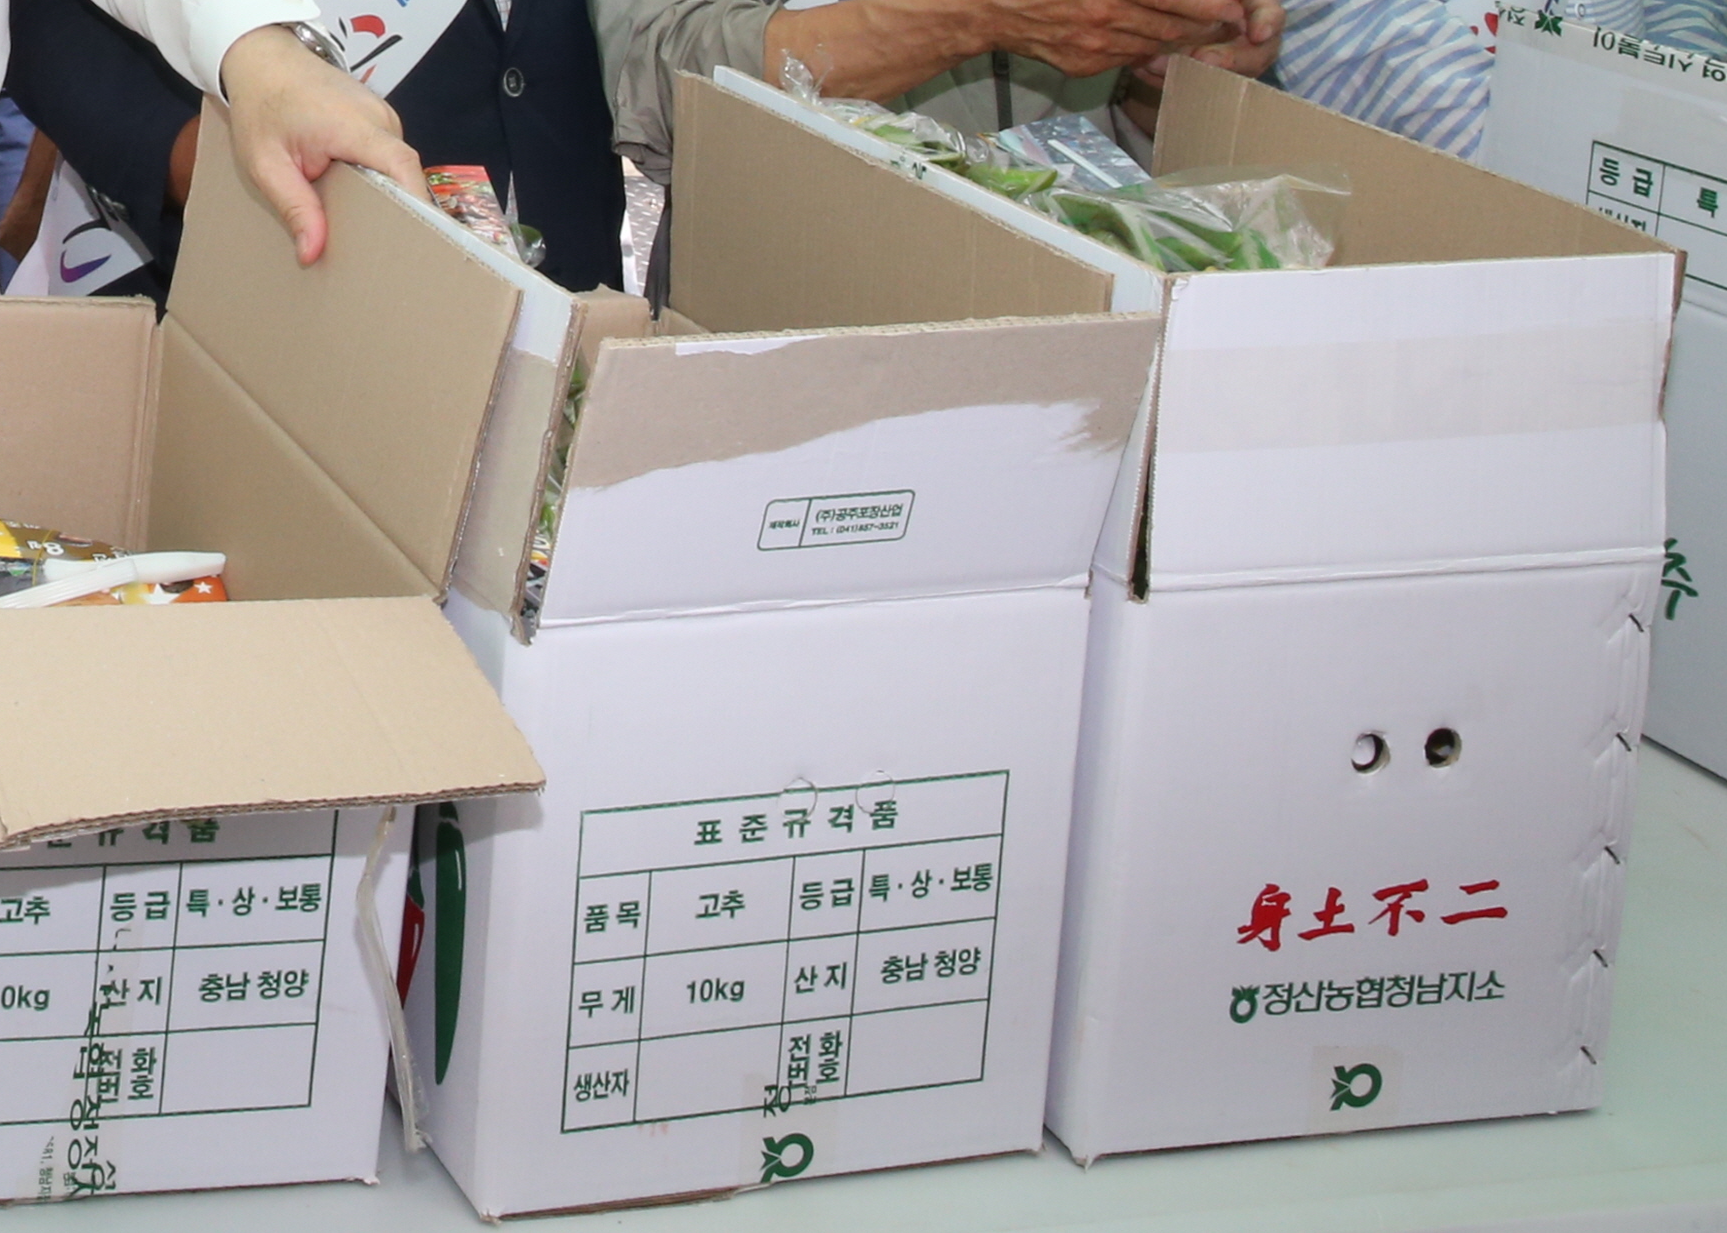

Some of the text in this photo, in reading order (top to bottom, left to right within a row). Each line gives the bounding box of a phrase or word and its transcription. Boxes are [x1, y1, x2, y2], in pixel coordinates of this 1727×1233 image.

[694, 888, 746, 921] 고추
[1236, 878, 1509, 953] 身土不二
[197, 972, 251, 1004] 충남
[257, 968, 310, 1001] 청양
[684, 976, 747, 1006] 10kg
[880, 952, 930, 986] 충남
[933, 946, 982, 980] 청양
[573, 1069, 631, 1102] 생산자
